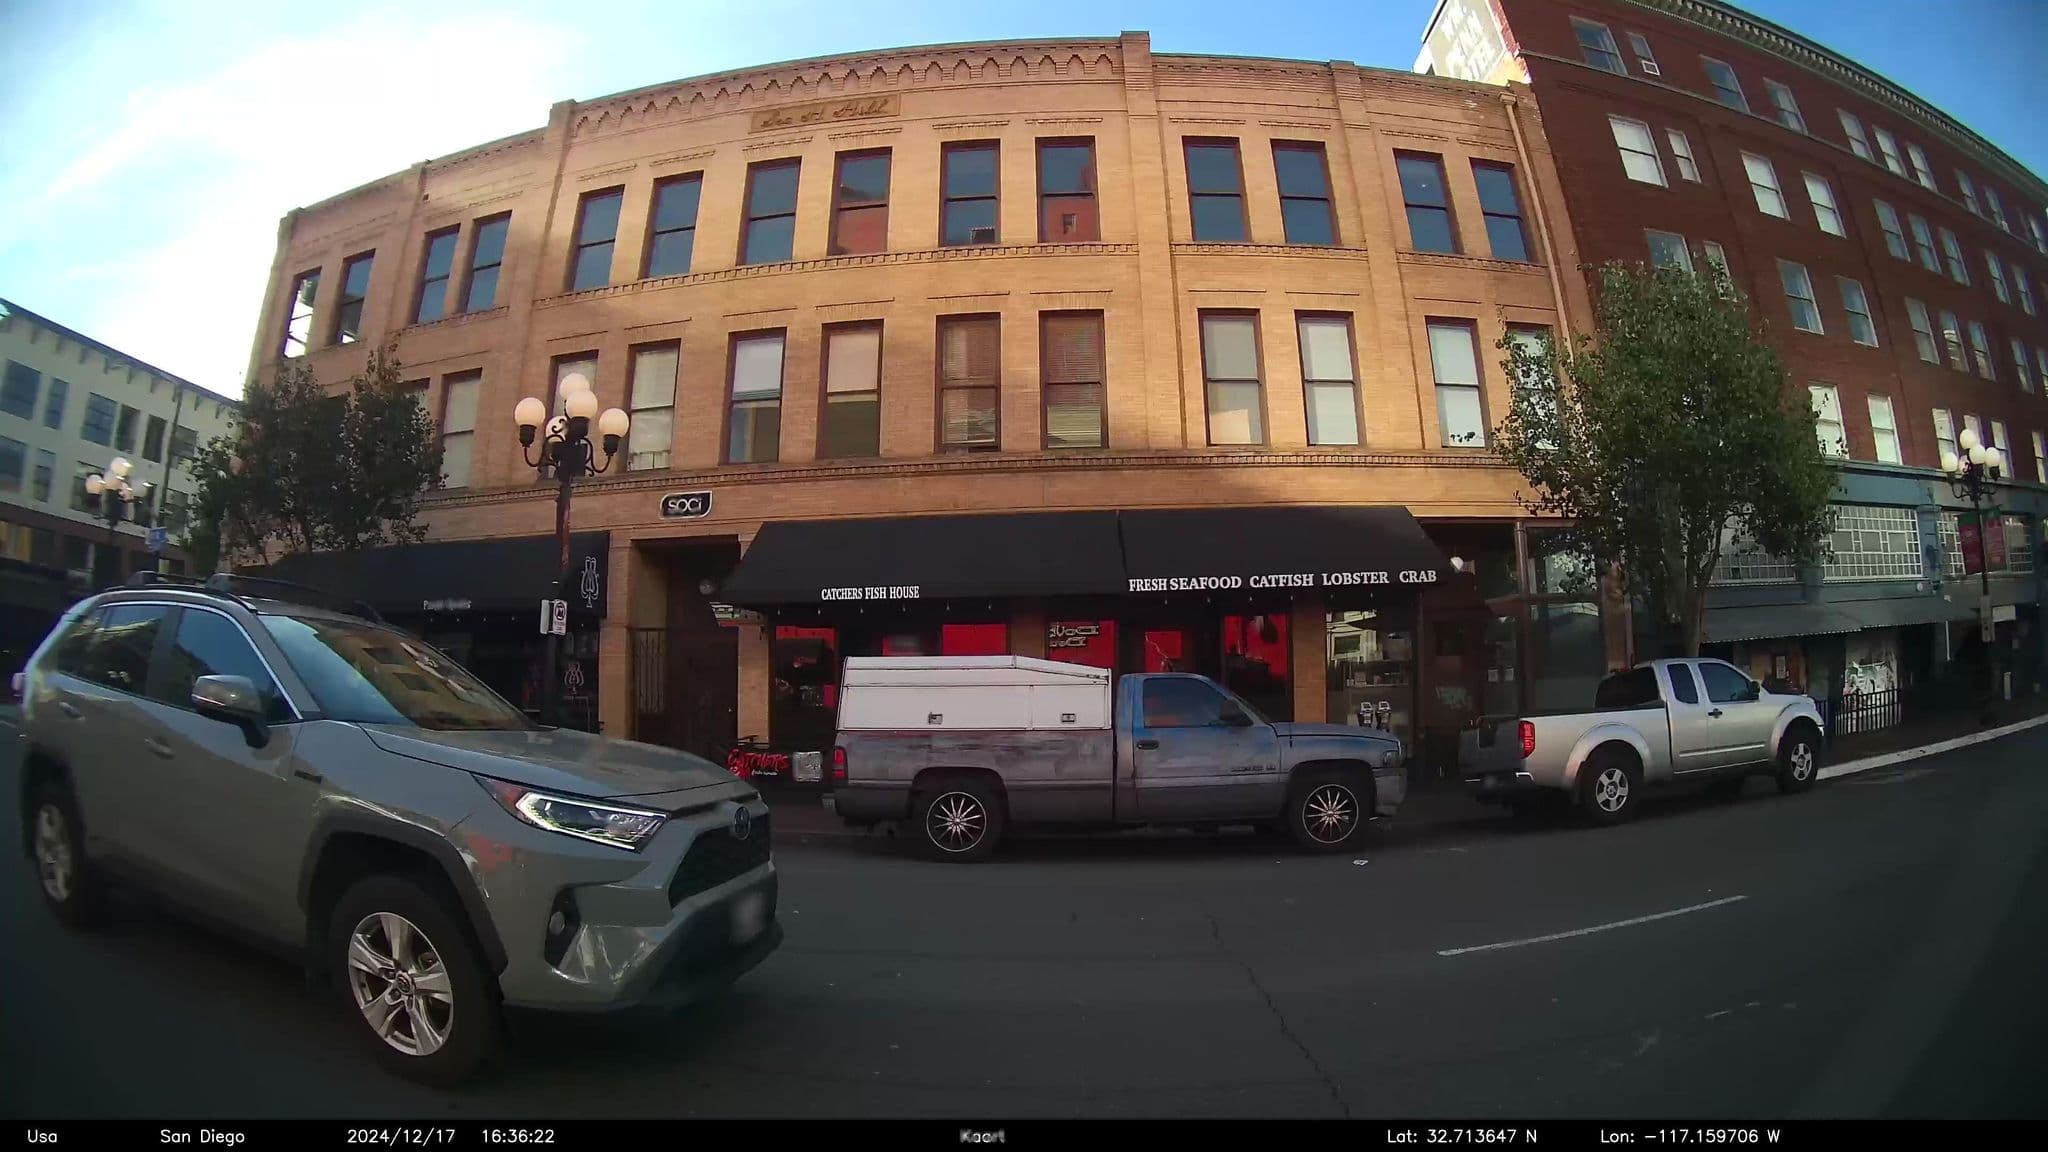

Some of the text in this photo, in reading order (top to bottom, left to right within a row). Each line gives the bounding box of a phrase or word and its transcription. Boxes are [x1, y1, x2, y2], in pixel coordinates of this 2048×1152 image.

[1128, 570, 1437, 592] FRESH SEAFOOD CATFISH LOBSTER CRAB
[821, 586, 920, 601] CATCHERS FISH HOUSE
